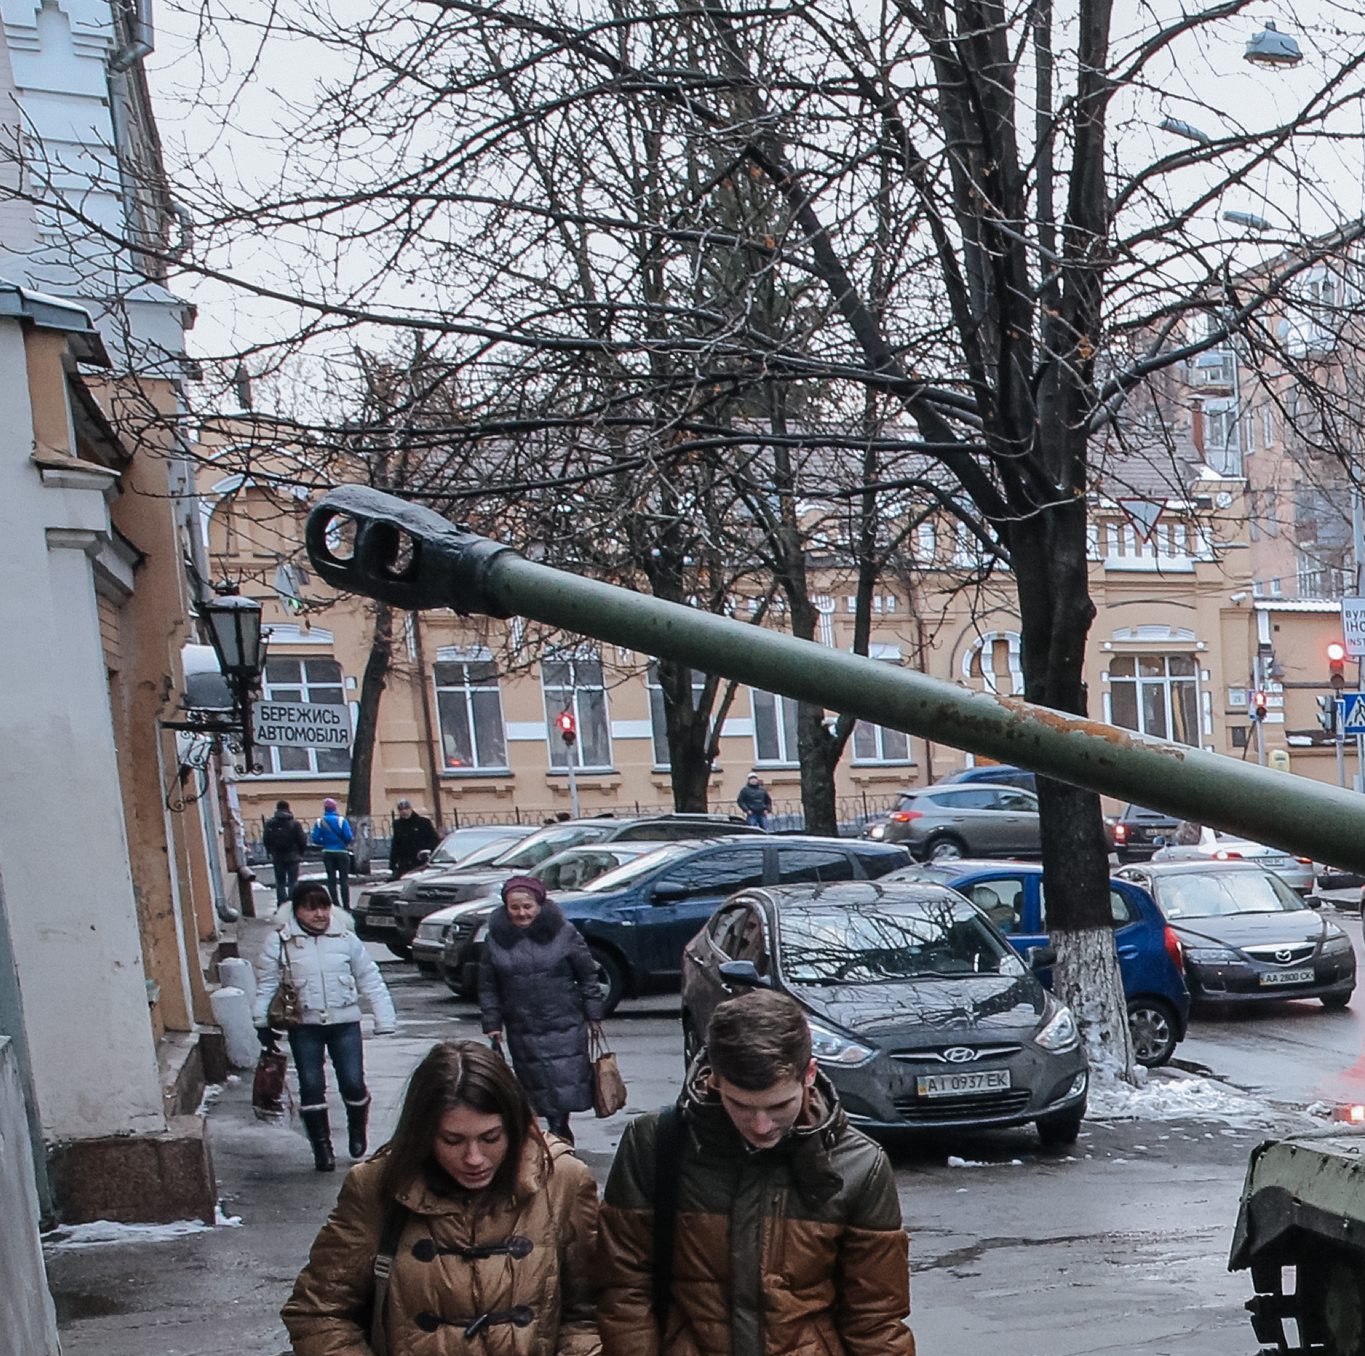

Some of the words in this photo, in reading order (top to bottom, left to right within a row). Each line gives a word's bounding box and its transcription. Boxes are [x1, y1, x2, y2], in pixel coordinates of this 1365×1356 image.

[260, 705, 341, 725] БЕРЕЖИСЬ
[257, 725, 348, 743] АВТОМОБІЛЯ
[928, 1078, 945, 1092] AI
[951, 1075, 984, 1090] 0937
[987, 1073, 1008, 1087] EK
